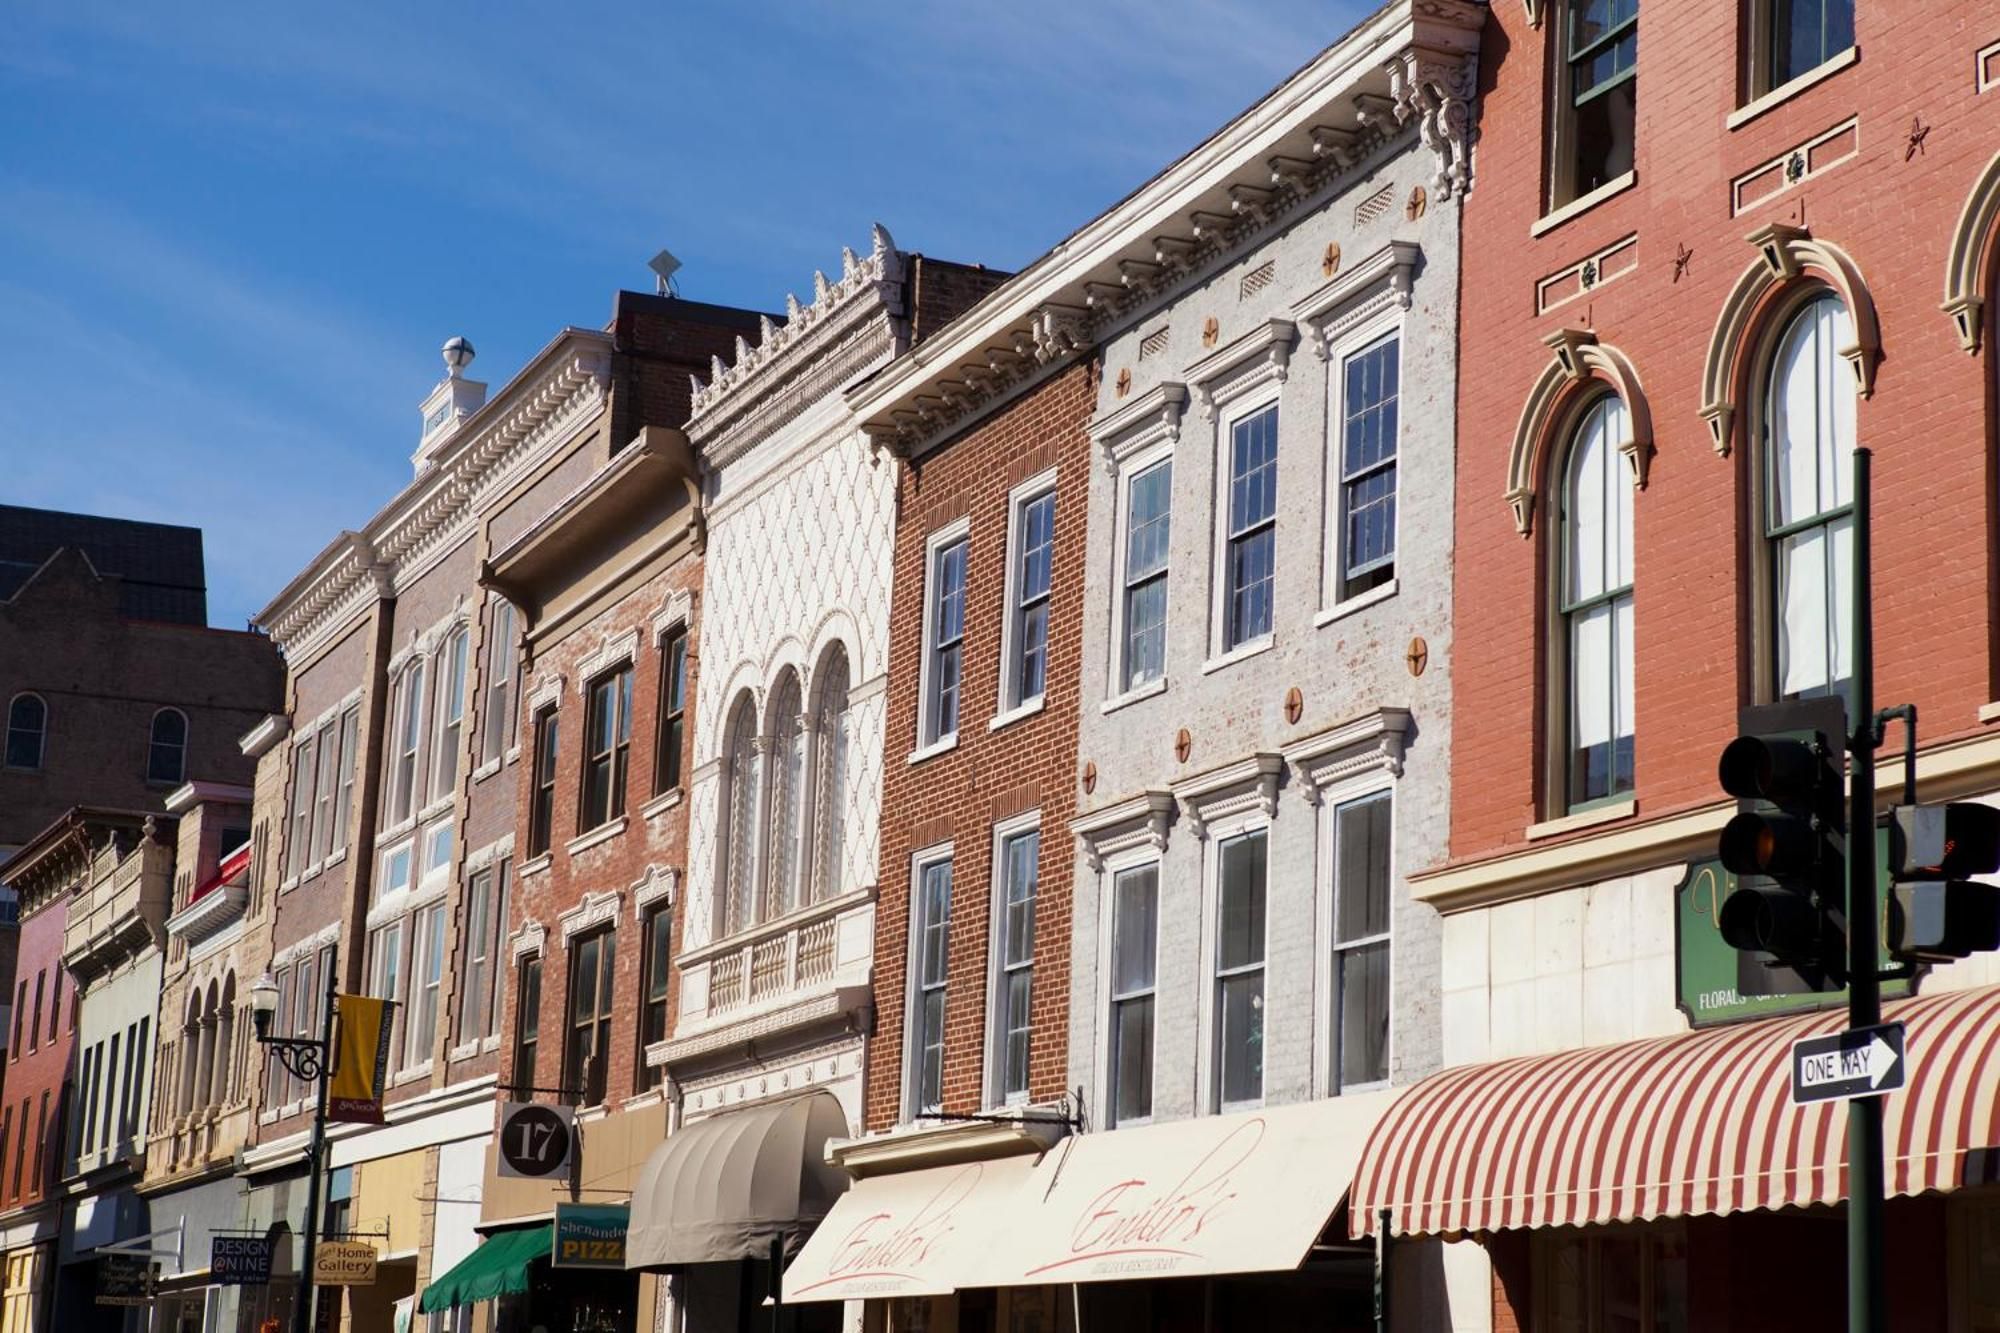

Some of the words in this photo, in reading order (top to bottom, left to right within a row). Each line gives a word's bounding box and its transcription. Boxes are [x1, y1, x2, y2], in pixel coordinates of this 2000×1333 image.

[1805, 1055, 1835, 1082] ONE
[1840, 1047, 1871, 1077] WAY
[511, 1121, 557, 1162] 17
[214, 1240, 269, 1256] DESIGN
[337, 1247, 374, 1258] Home
[562, 1240, 627, 1259] PIZZ
[213, 1256, 269, 1273] @NINE
[317, 1260, 372, 1274] Gallery
